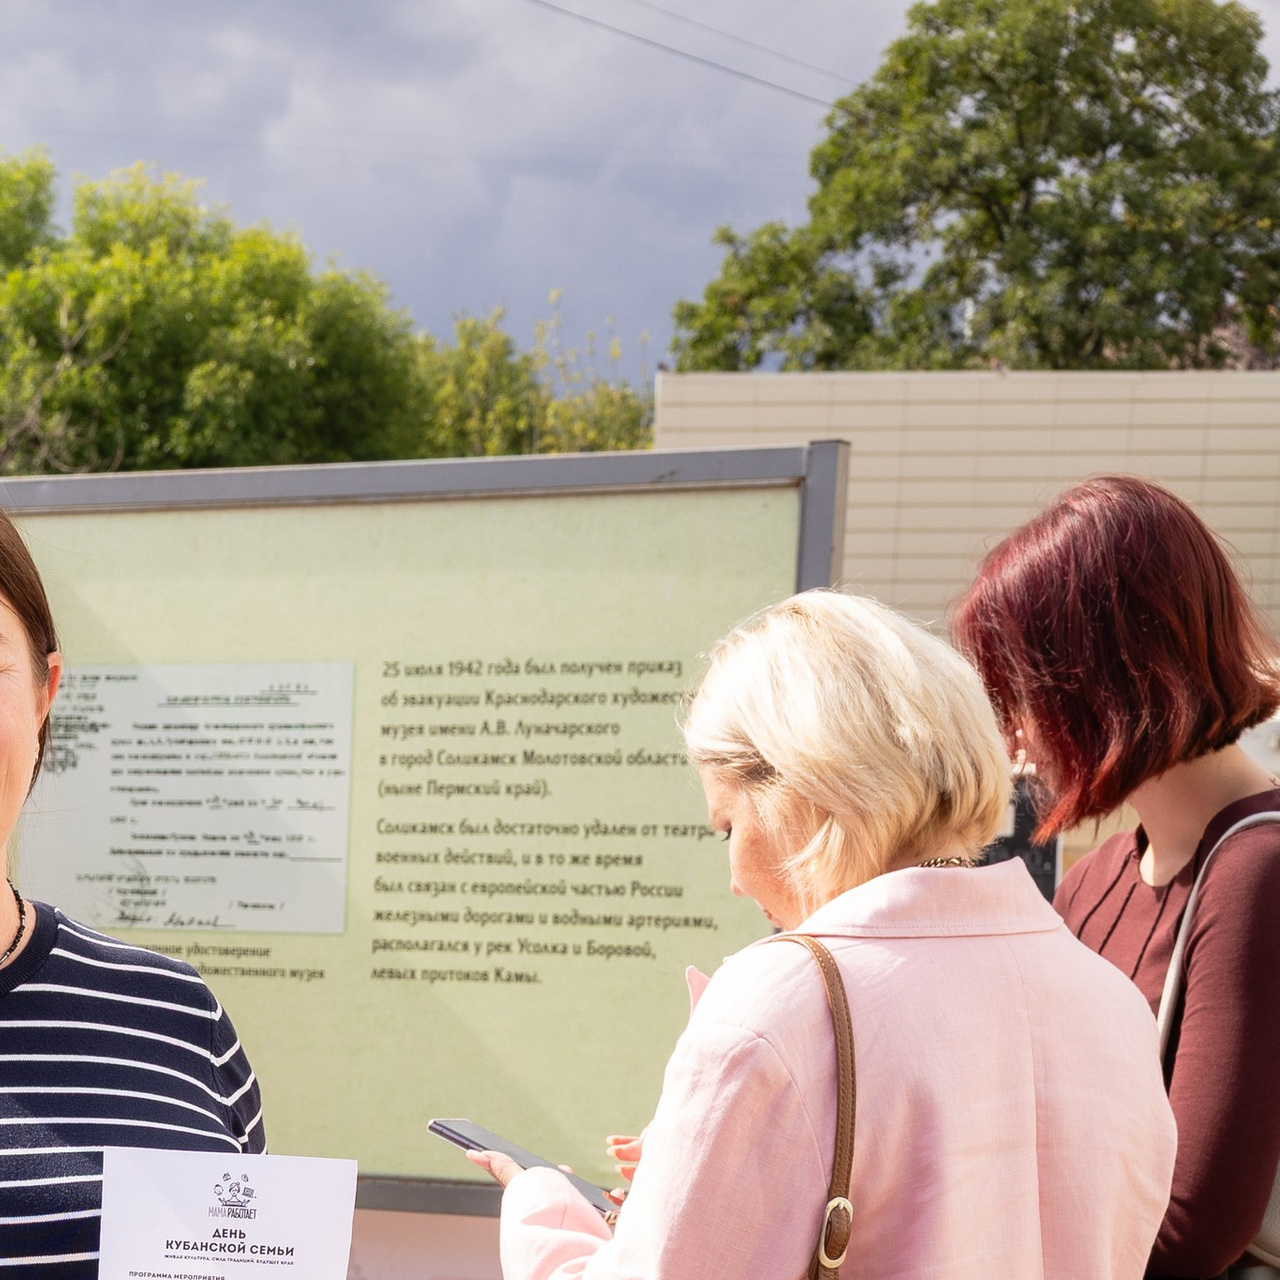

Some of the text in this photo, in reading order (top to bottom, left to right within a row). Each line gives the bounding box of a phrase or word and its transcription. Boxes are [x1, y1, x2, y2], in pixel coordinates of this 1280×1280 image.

[383, 658, 683, 678] 25 июля 1942 года был получен приказ
[381, 688, 608, 709] об эвакуации Краснодарского
[381, 724, 425, 740] музея
[429, 724, 476, 736] имени
[515, 720, 620, 739] Луначарского
[379, 754, 387, 766] в
[391, 749, 433, 769] город
[437, 750, 517, 766] Соликамск
[522, 749, 622, 766] Молотовской
[378, 781, 423, 798] (ныне
[427, 779, 501, 799] Пермский
[377, 818, 659, 839] Соликамск был достаточно удален от
[376, 852, 440, 864] военных
[522, 854, 531, 866] и
[535, 854, 544, 865] в
[548, 853, 565, 866] то
[570, 854, 590, 866] же
[595, 854, 643, 869] время
[374, 876, 683, 898] был связан с европейской частью России
[373, 910, 459, 926] железными
[463, 906, 534, 927] дорогами
[538, 913, 548, 925] и
[552, 909, 623, 927] водными
[372, 939, 469, 954] располагался
[473, 942, 482, 956] у
[486, 942, 512, 956] рек
[518, 938, 568, 955] Усолка
[573, 944, 582, 956] и
[289, 969, 325, 982] музея
[371, 968, 416, 980] левых
[421, 969, 489, 984] притоков
[209, 1207, 256, 1219] МАМА РАБОТАЕТ
[212, 1228, 246, 1239] ДЕНЬ
[166, 1240, 294, 1256] КУБАНСКОЙ СЕМЬИ
